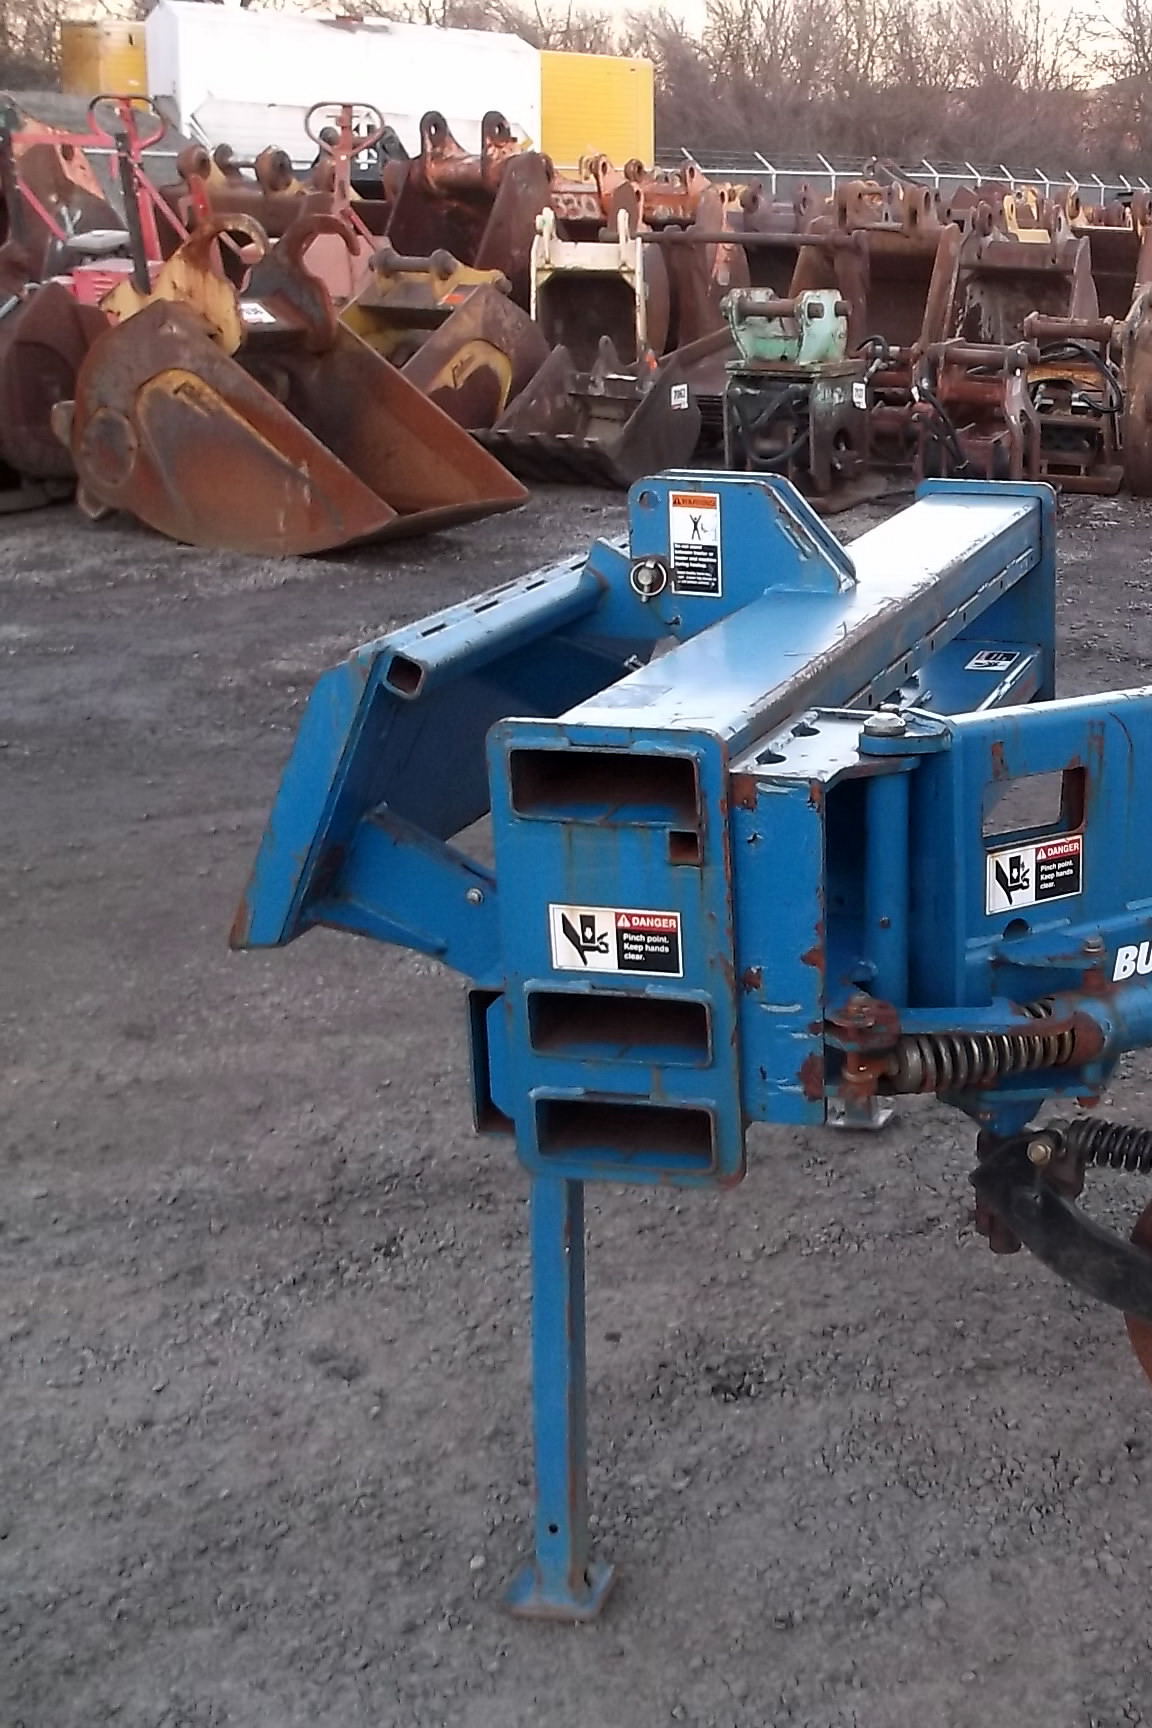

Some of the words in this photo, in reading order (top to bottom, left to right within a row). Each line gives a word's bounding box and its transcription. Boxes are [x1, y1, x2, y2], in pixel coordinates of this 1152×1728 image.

[1047, 842, 1080, 857] DANGER
[1040, 862, 1057, 873] Pinch
[1040, 872, 1056, 881] Keep
[1056, 868, 1074, 878] hands
[1040, 881, 1056, 890] clear.
[631, 916, 677, 929] DANGER
[623, 932, 645, 942] Pinch
[646, 934, 670, 944] point.
[623, 942, 644, 953] Keep
[644, 943, 670, 954] hands
[623, 952, 646, 961] clear.
